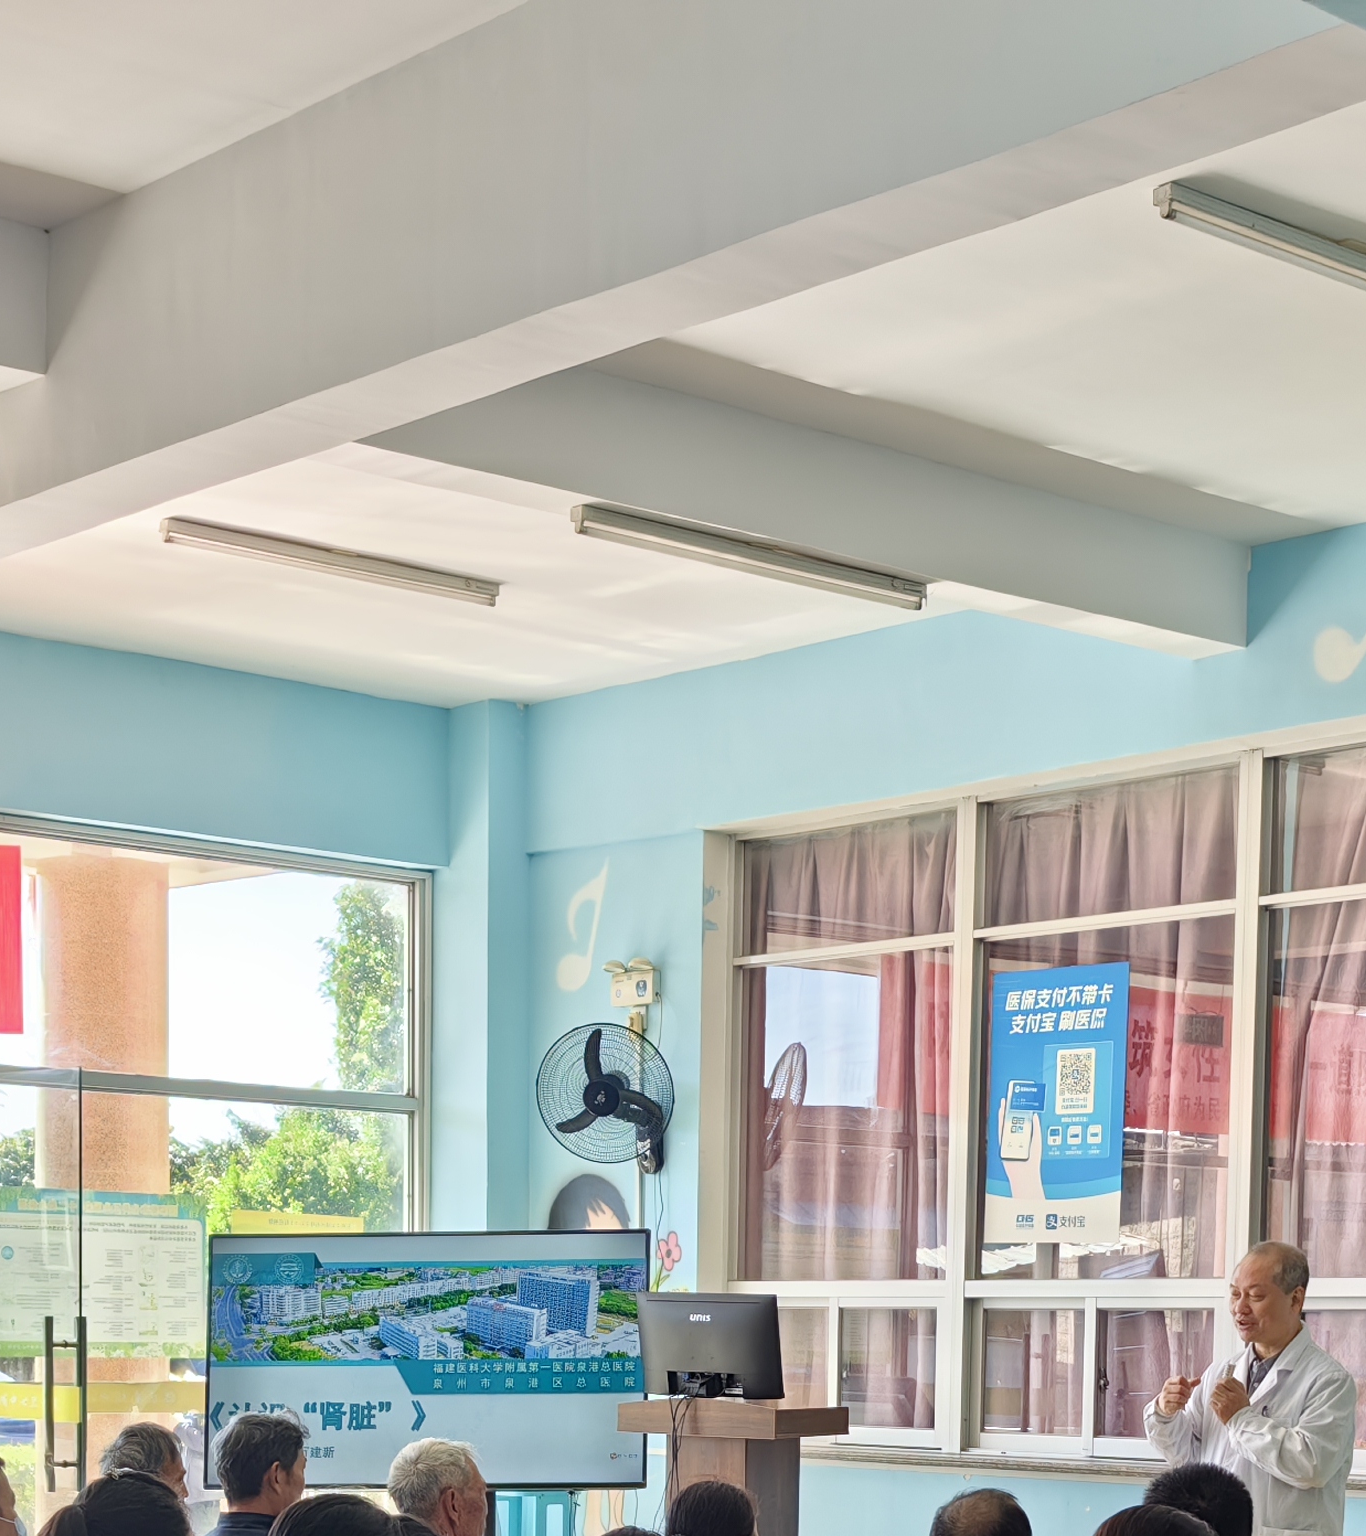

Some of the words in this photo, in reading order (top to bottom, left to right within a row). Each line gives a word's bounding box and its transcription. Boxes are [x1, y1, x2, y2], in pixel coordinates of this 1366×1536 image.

[1005, 983, 1114, 1011] 医保支付不带卡
[1009, 1012, 1057, 1035] 支付宝
[1058, 1007, 1108, 1031] 刷医保
[1058, 1214, 1086, 1228] 支付宝
[433, 1361, 636, 1375] 福建医科大学附属第一医院泉港总医院
[433, 1376, 636, 1389] 泉州市泉港区总医院
